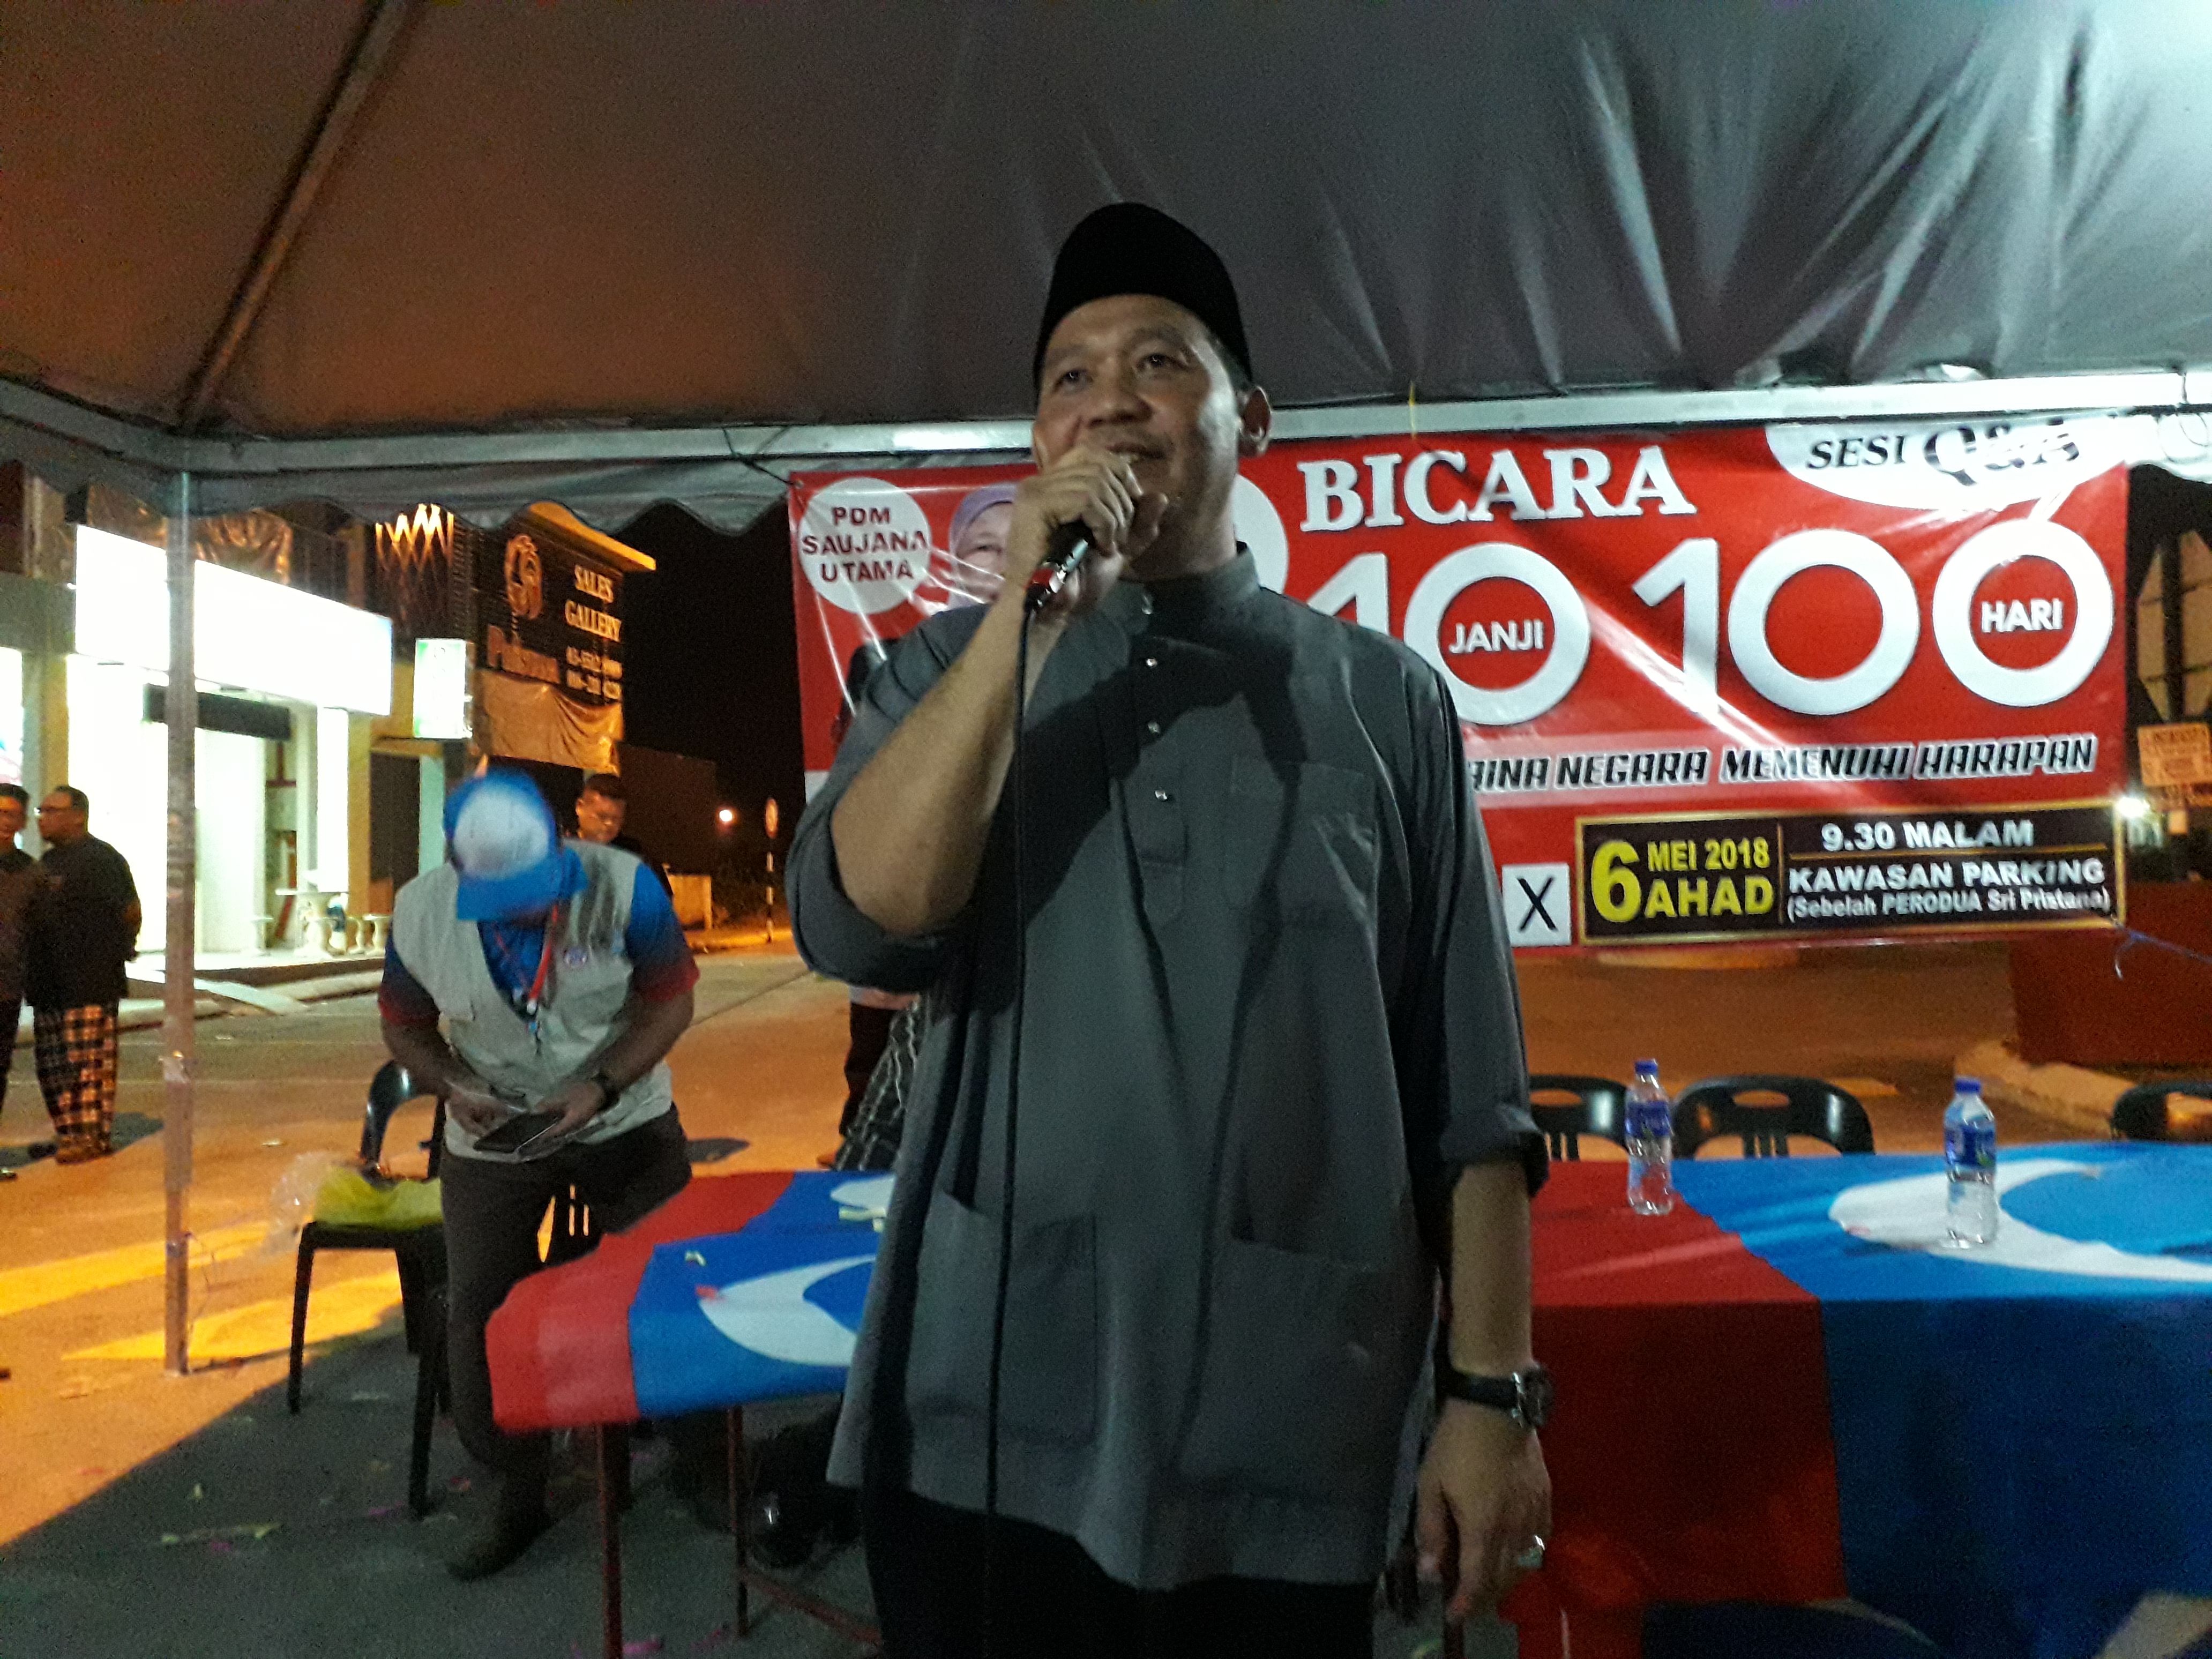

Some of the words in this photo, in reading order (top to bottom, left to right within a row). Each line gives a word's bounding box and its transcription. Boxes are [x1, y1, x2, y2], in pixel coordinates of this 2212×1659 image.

[1806, 435, 1906, 469] SESI
[1297, 445, 1698, 532] BICARA
[832, 507, 890, 525] PDM
[802, 530, 928, 554] SAUJANA
[574, 565, 614, 603] SALES
[821, 560, 914, 582] UTAMA
[565, 600, 622, 642] GALLERY
[1632, 517, 2114, 715] 100
[1981, 598, 2062, 632] HARI
[1448, 619, 1544, 654] JANJI
[1555, 749, 1709, 789] NEGARA
[1719, 742, 1915, 782] MEMENUHI
[1914, 734, 2097, 780] HARAPAN
[1821, 823, 1895, 851] 9.30
[1903, 819, 2035, 849] MALAM
[1591, 840, 1642, 922] 6
[1648, 840, 1697, 872] MEI
[1705, 836, 1770, 870] 2018
[1788, 861, 1954, 893] KAWASAN
[1963, 858, 2106, 887] PARKING
[1644, 875, 1774, 918] AHAD
[1882, 888, 1983, 915] PERODUA
